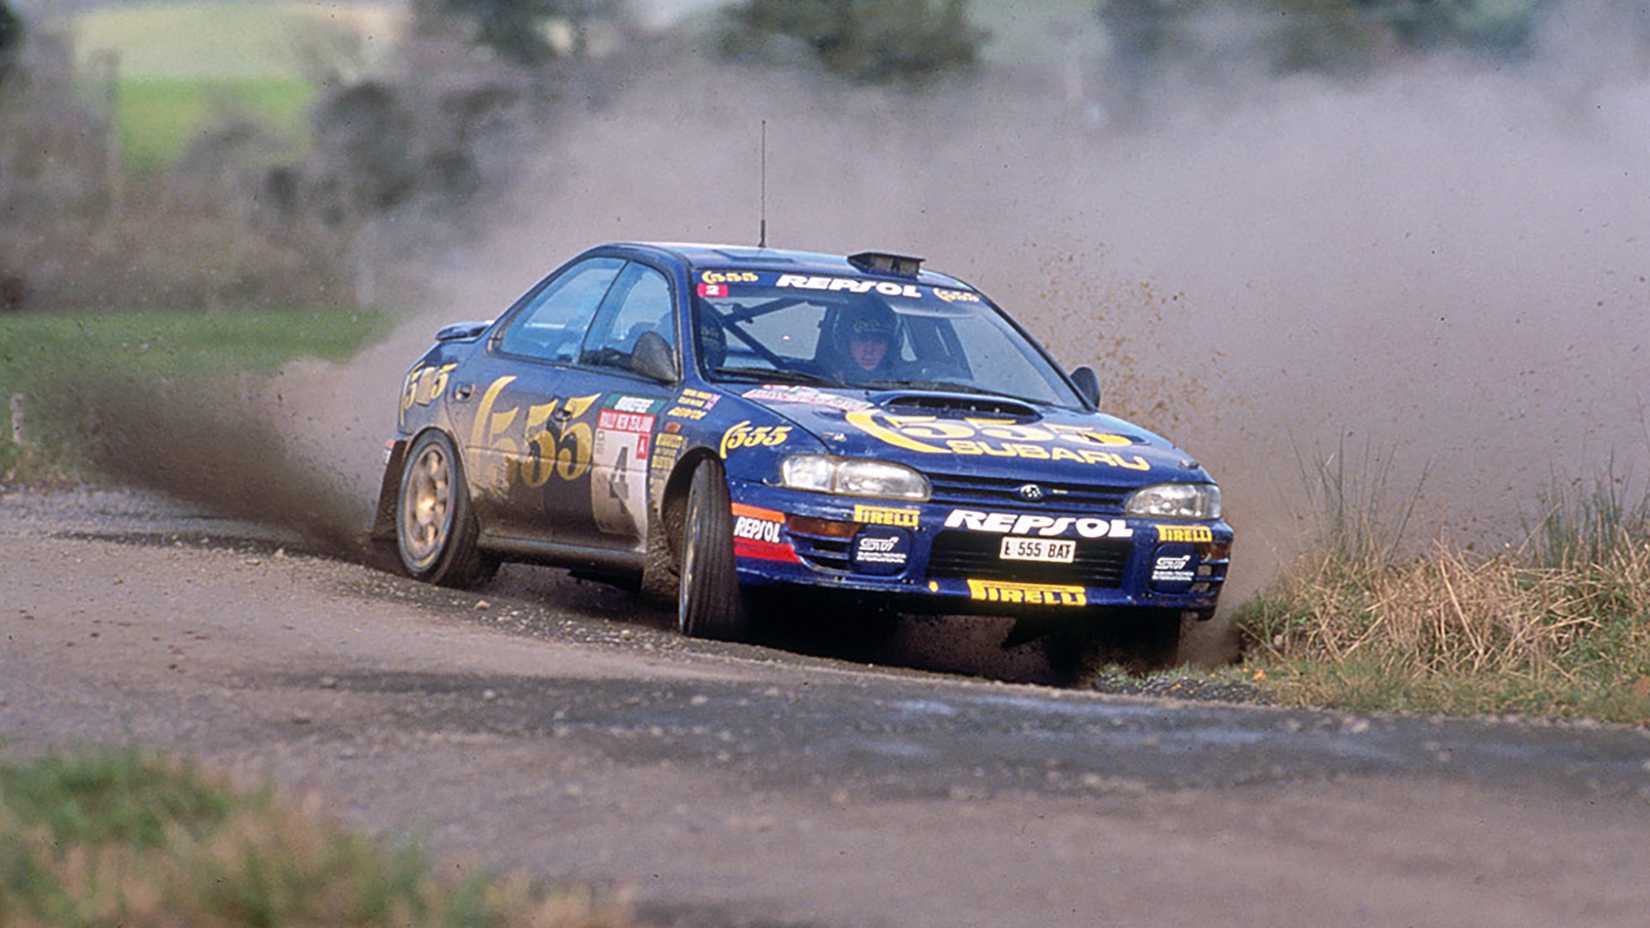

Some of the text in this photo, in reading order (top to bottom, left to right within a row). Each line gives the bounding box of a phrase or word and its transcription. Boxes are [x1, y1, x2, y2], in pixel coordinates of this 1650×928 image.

[705, 285, 721, 296] 2
[776, 274, 923, 299] REPSOL
[725, 422, 793, 453] 555
[886, 415, 1134, 449] 555
[948, 439, 1150, 472] SUBARU
[854, 505, 920, 527] PIRELLI
[945, 510, 1135, 539] REPSOL
[733, 517, 781, 543] REPSOL
[1156, 525, 1213, 542] PIRELLI
[1017, 542, 1042, 557] 555
[1047, 544, 1072, 559] BAT
[967, 579, 1088, 607] PIRELLI
